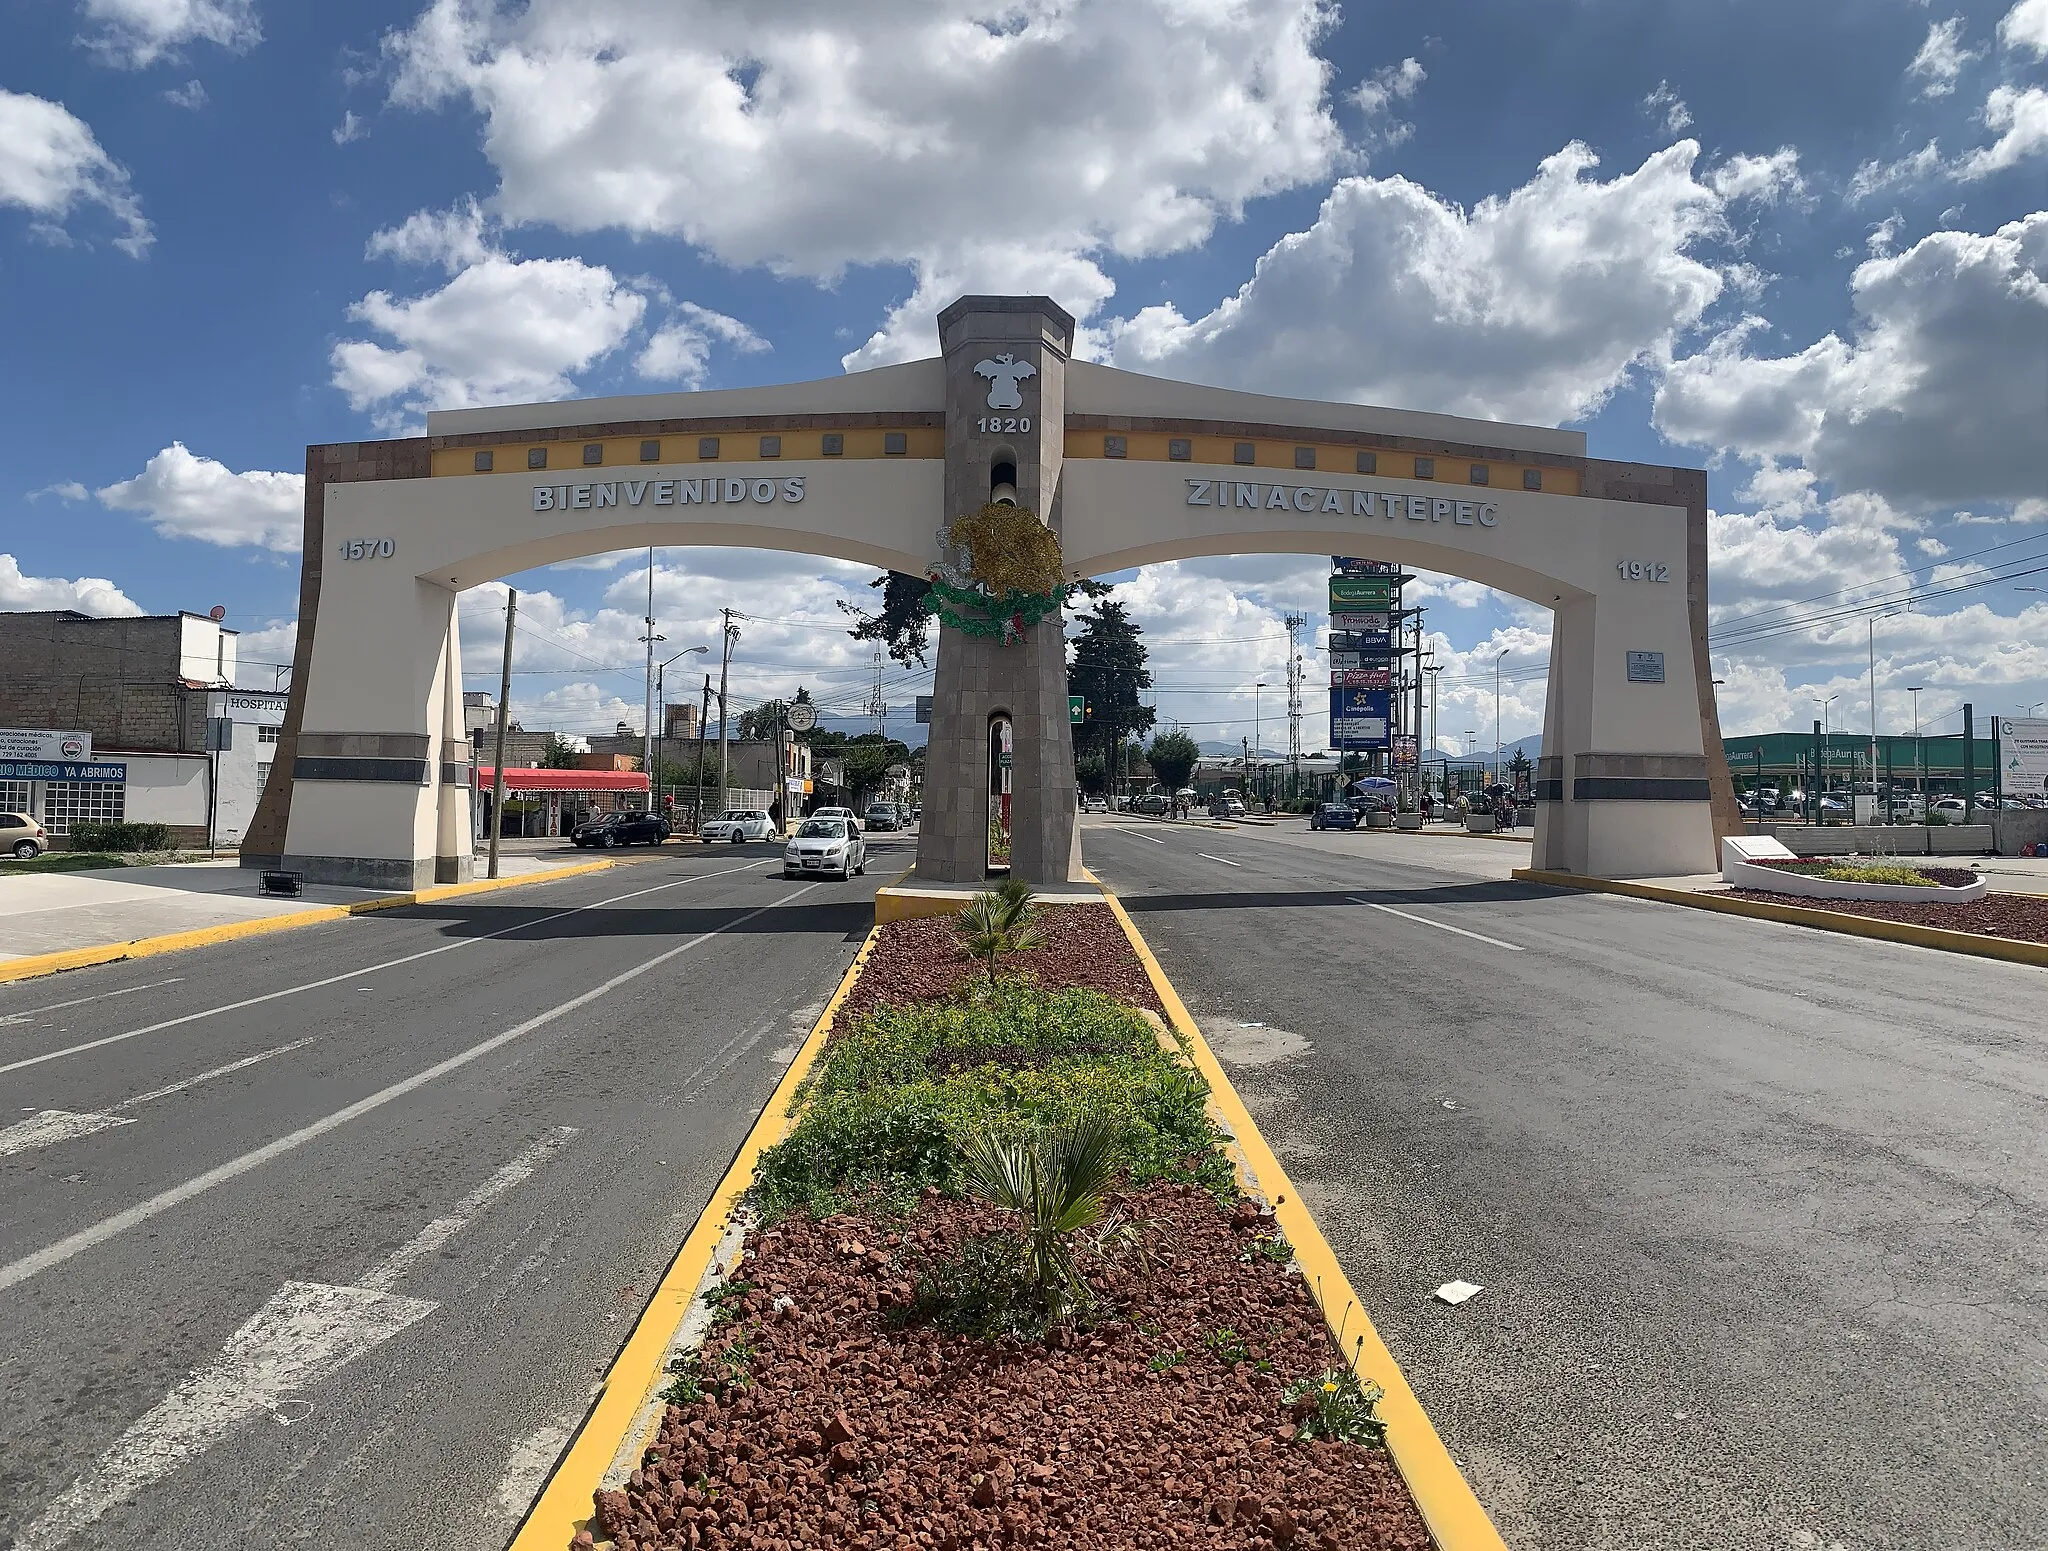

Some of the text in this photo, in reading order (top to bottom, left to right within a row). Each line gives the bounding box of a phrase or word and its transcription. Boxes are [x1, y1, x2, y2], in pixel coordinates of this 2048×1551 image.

[977, 417, 1032, 434] 1820
[533, 478, 806, 511] BIENVENIDOS
[1186, 480, 1498, 527] ZINACANTEPEC
[338, 537, 396, 561] 1570
[1617, 559, 1671, 583] 1912
[1365, 636, 1387, 644] BBVA
[1369, 671, 1386, 679] Hut
[15, 762, 59, 777] MÉDICO
[64, 766, 76, 777] YA
[80, 767, 123, 778] ABRIMOS
